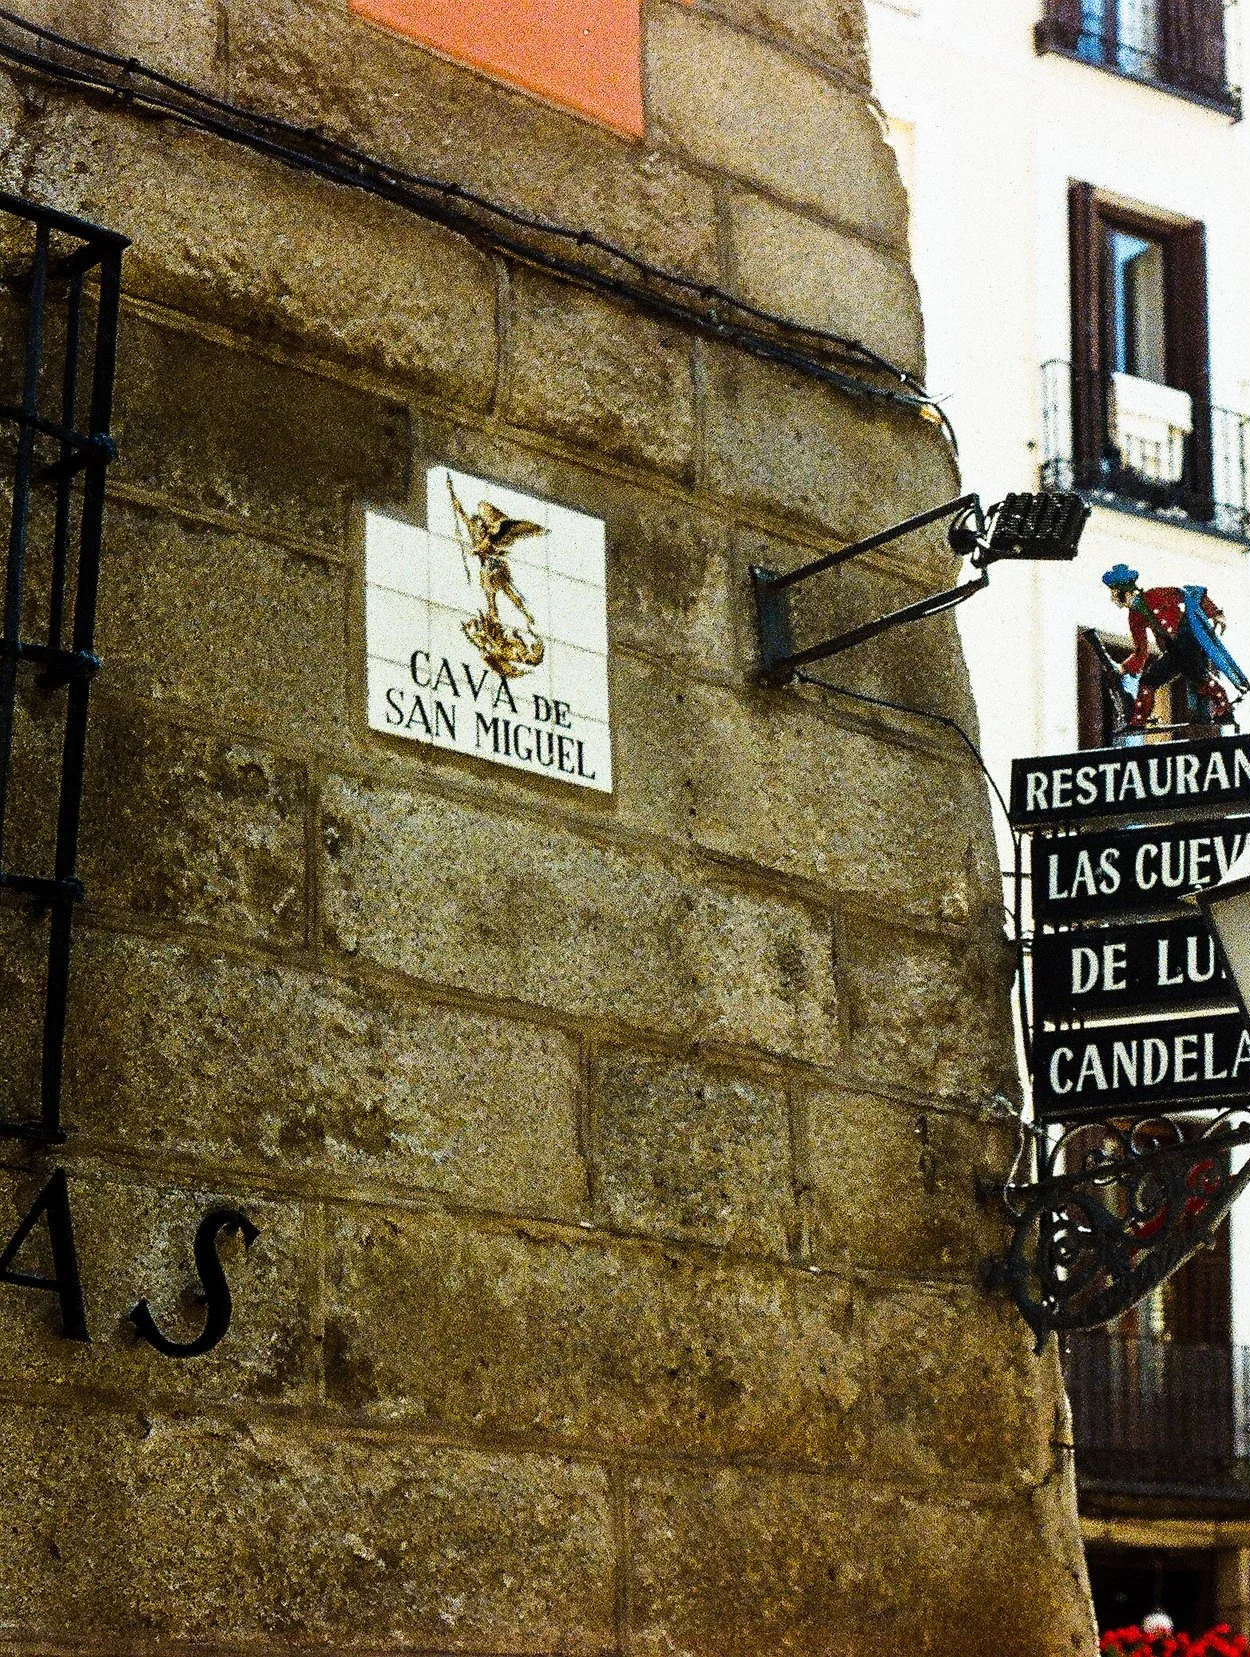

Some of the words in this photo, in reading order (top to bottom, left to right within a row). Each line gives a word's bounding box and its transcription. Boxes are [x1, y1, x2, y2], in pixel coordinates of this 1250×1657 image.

[410, 650, 519, 713] CAVA
[533, 694, 572, 729] DE
[385, 687, 457, 740] SAN
[475, 711, 596, 780] MIGUEL
[1048, 848, 1121, 901] LAS
[1070, 942, 1128, 995] DE
[1157, 934, 1227, 986] LU
